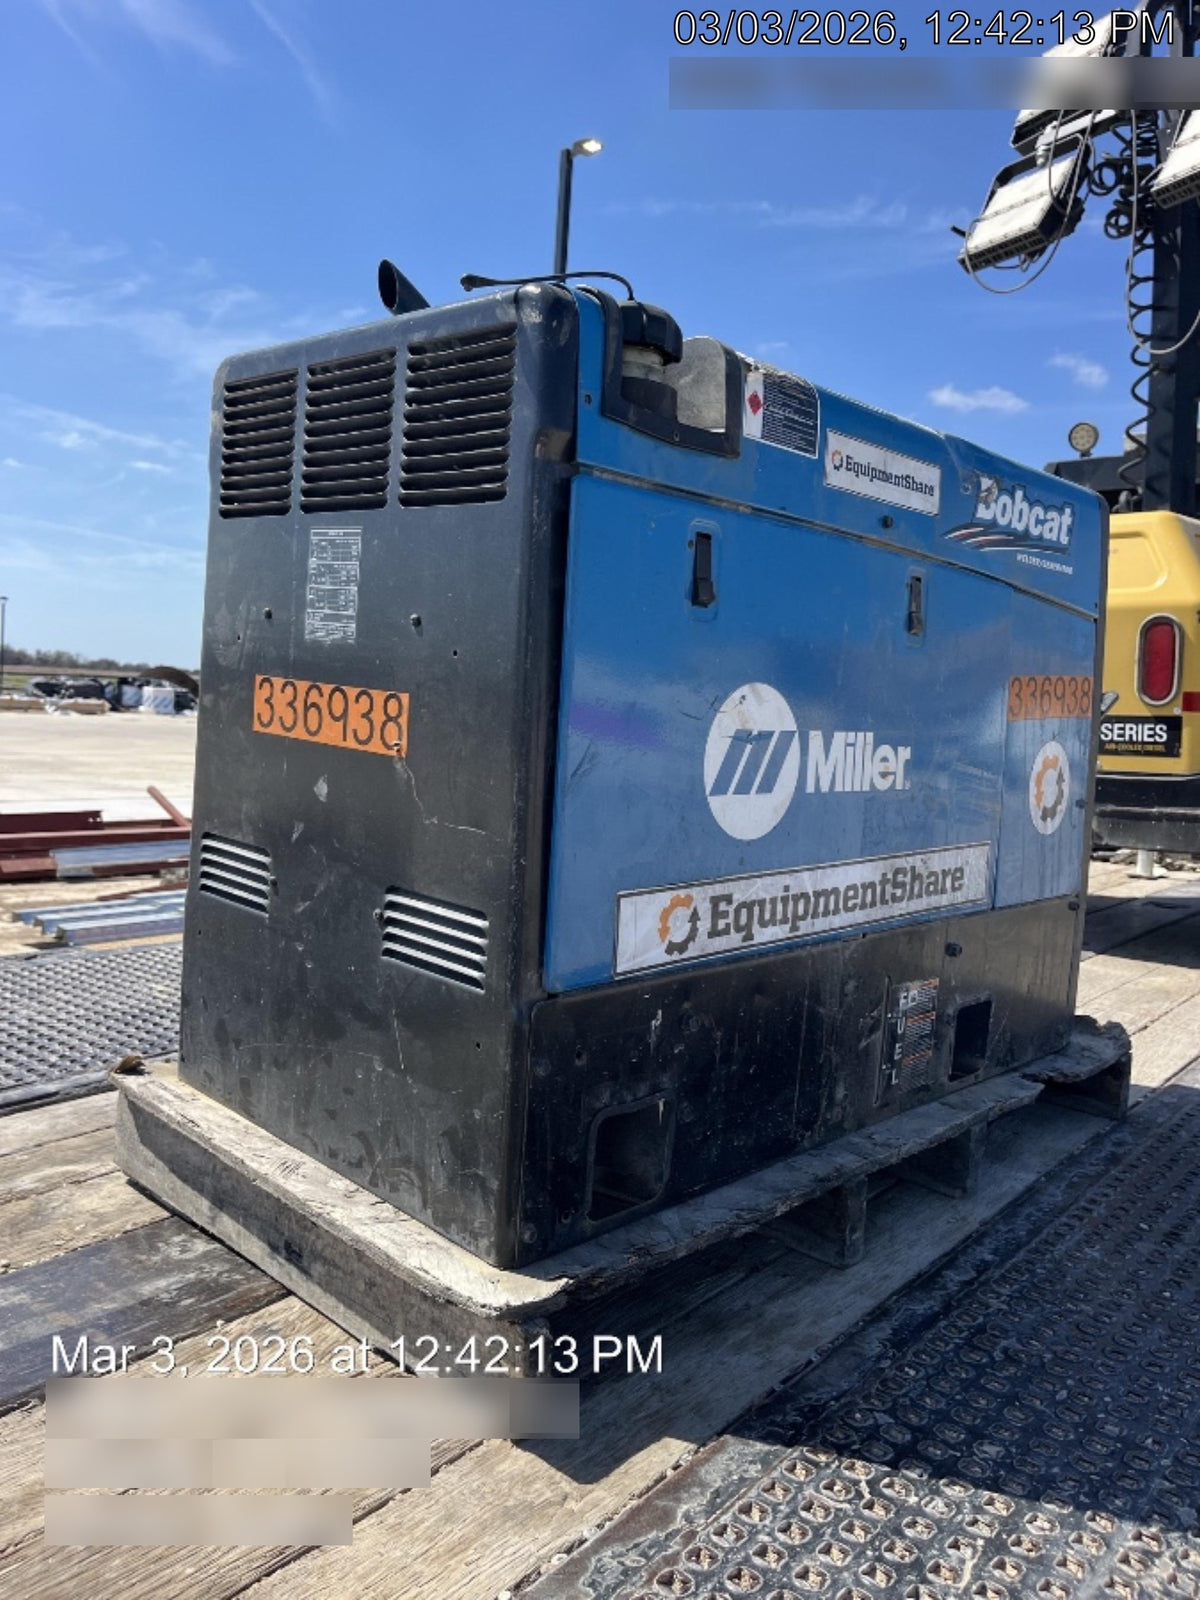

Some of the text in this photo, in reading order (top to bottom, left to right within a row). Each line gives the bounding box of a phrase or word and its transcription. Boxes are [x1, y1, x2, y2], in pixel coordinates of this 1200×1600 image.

[845, 454, 935, 497] EquipmentShare
[976, 476, 1073, 545] Bobcat
[256, 676, 403, 751] 336938
[1009, 676, 1091, 716] 336938
[805, 730, 912, 794] Miller
[1100, 722, 1168, 743] SERIES
[706, 864, 965, 943] EquipmentShare
